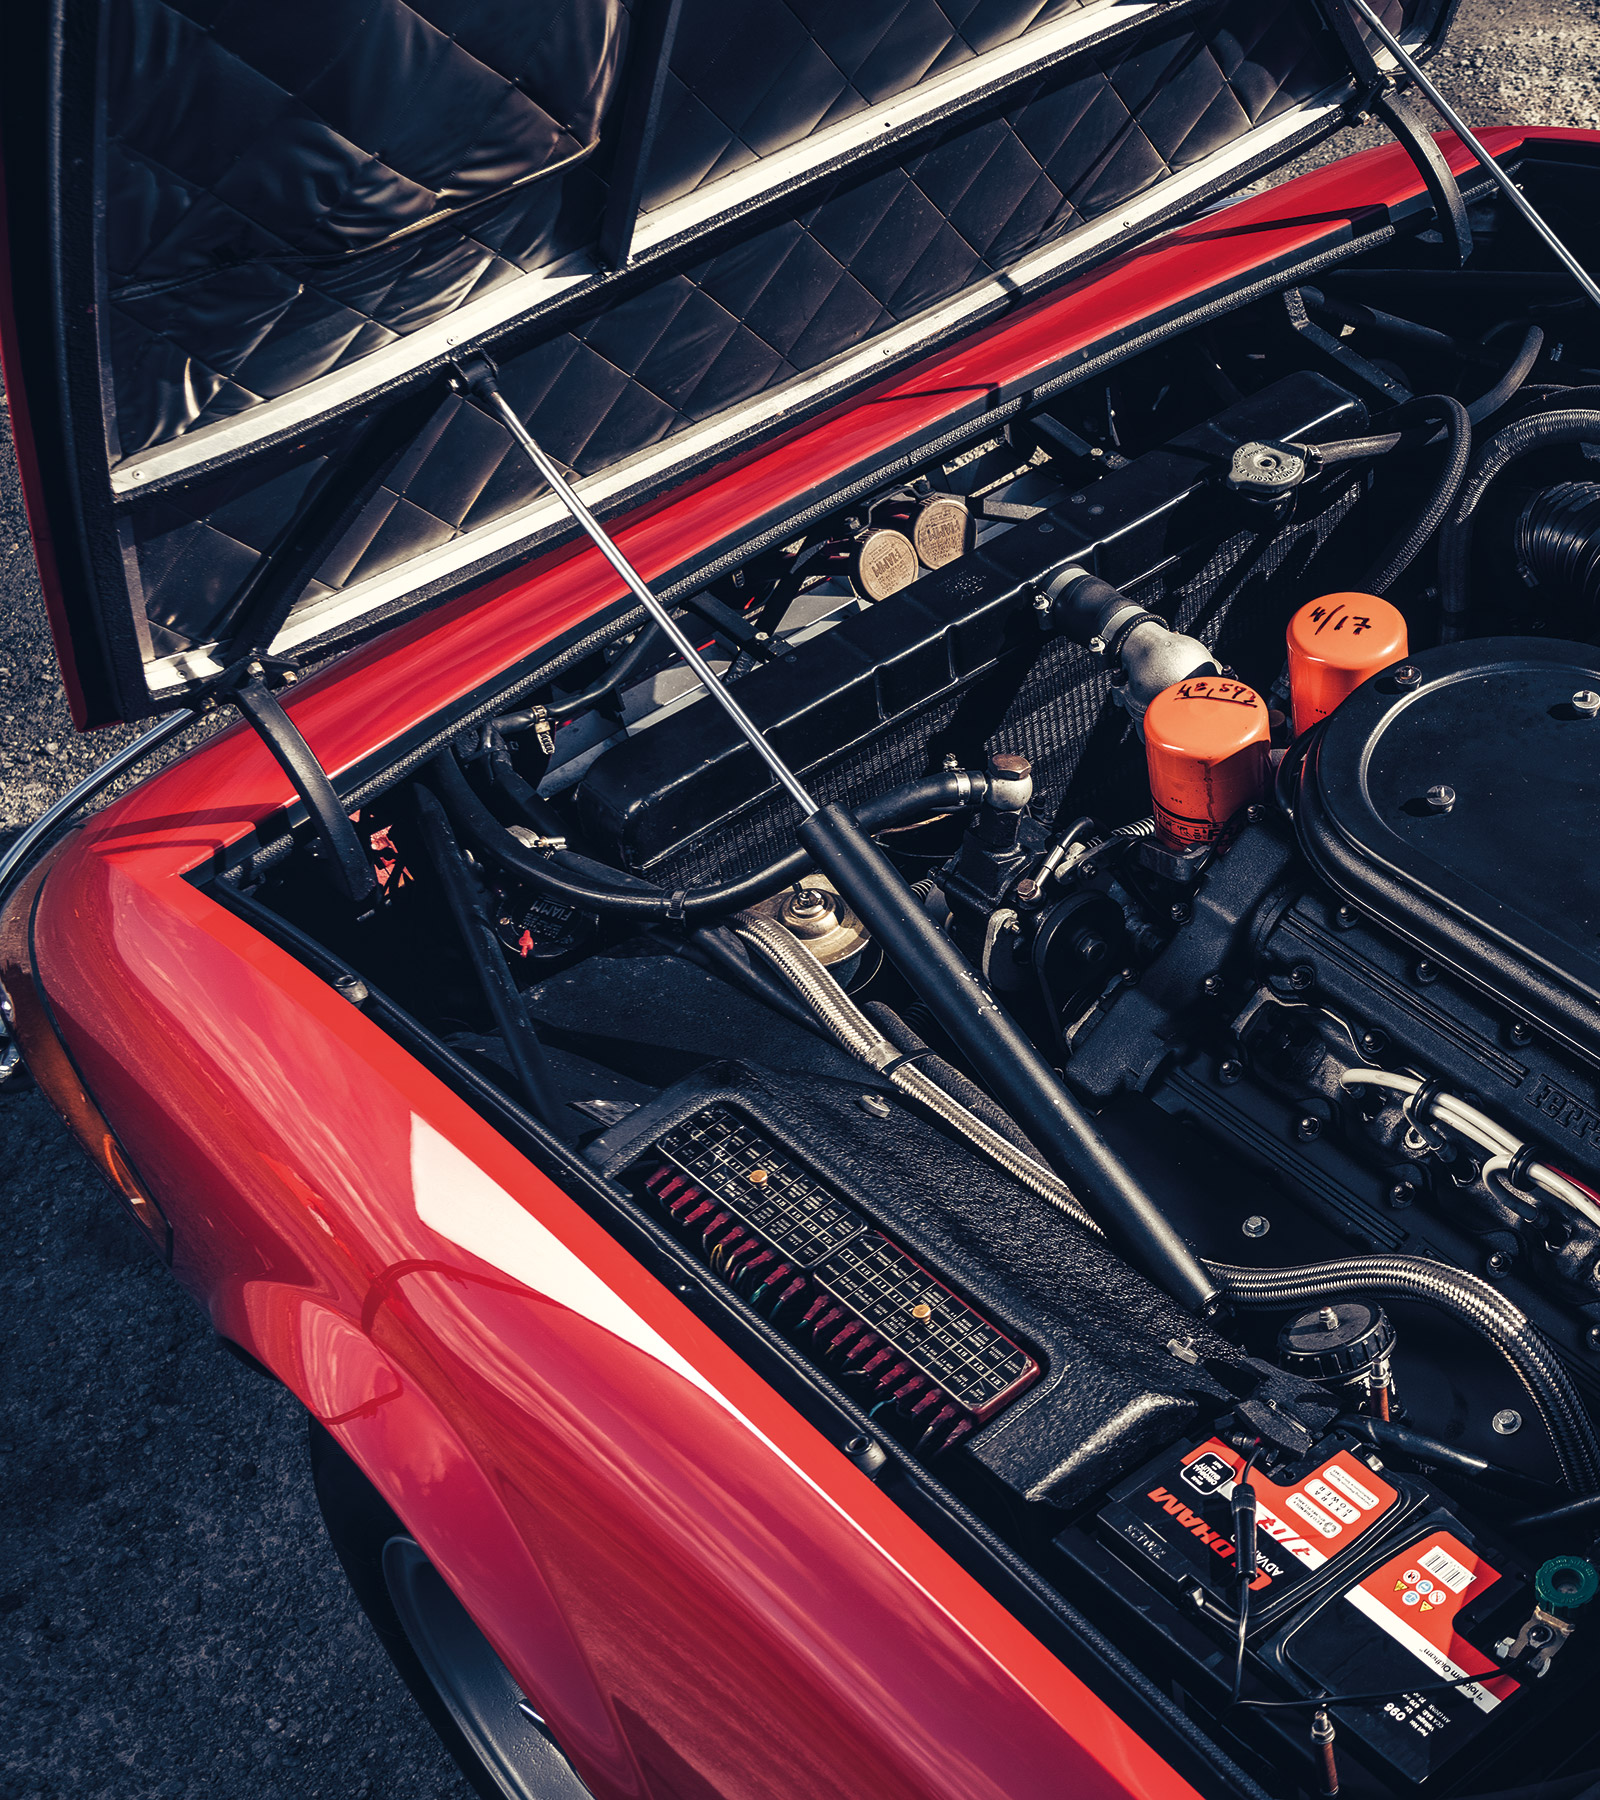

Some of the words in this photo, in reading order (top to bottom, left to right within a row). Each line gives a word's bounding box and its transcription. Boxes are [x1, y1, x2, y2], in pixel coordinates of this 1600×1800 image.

[926, 519, 961, 542] FIAMM
[870, 547, 902, 578] FIAMM
[529, 899, 572, 921] FIAMM
[1313, 1489, 1348, 1518] EXTRA
[1317, 1484, 1353, 1514] POWER
[1146, 1485, 1273, 1593] ODHAM
[1382, 1700, 1407, 1723] 096
[1432, 1717, 1444, 1729] CCA
